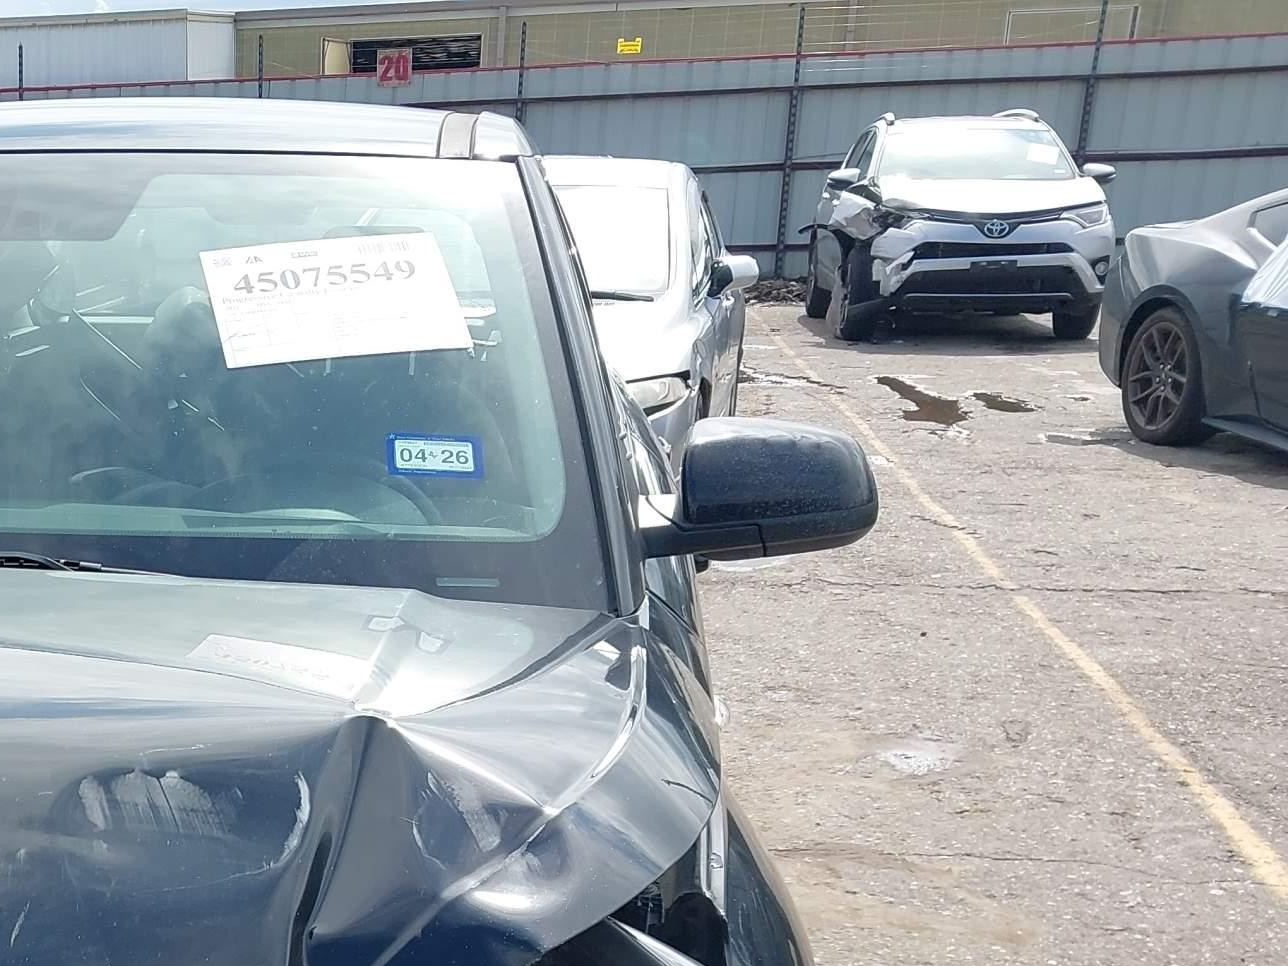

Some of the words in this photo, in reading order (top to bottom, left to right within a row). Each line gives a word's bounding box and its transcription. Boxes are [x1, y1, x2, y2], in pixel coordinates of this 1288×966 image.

[378, 53, 409, 81] 20
[233, 259, 416, 294] 45075549
[400, 448, 428, 463] 04
[441, 449, 469, 465] 26
